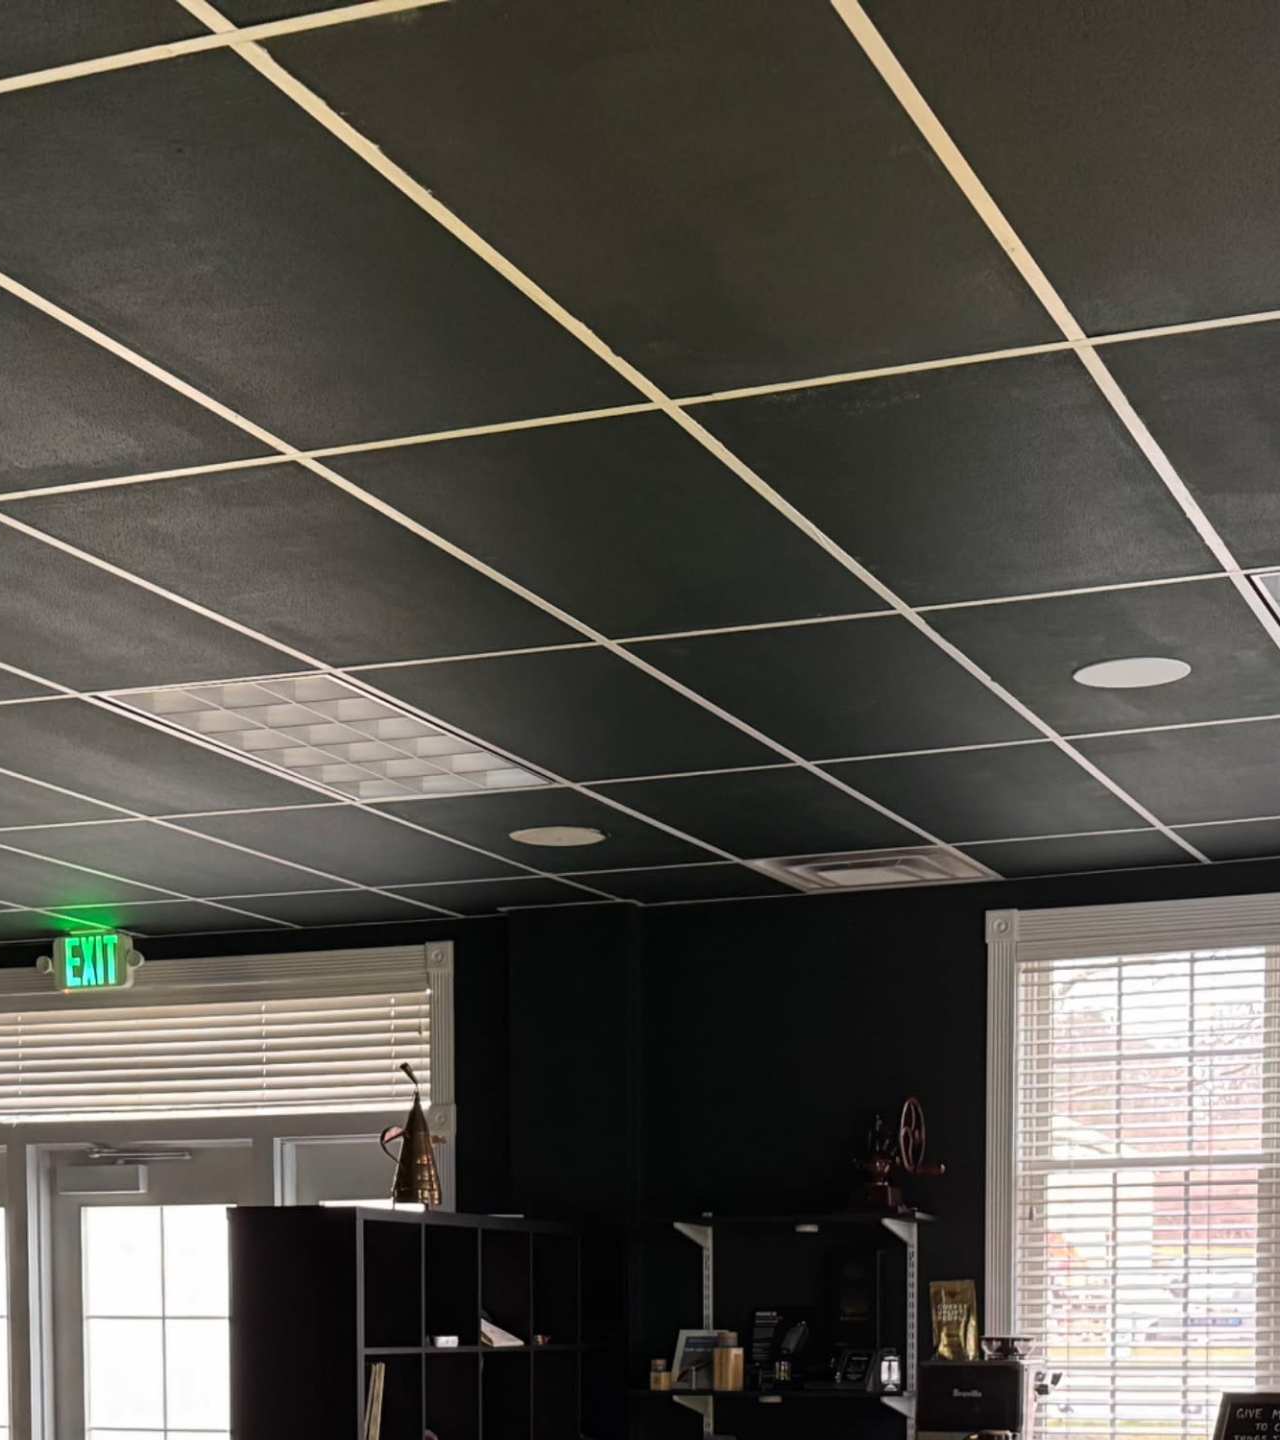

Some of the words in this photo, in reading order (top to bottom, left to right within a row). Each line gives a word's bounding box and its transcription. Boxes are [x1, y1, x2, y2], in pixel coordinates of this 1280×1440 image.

[65, 934, 118, 987] EXIT
[1236, 1407, 1264, 1419] GIVE
[1255, 1422, 1269, 1432] TO
